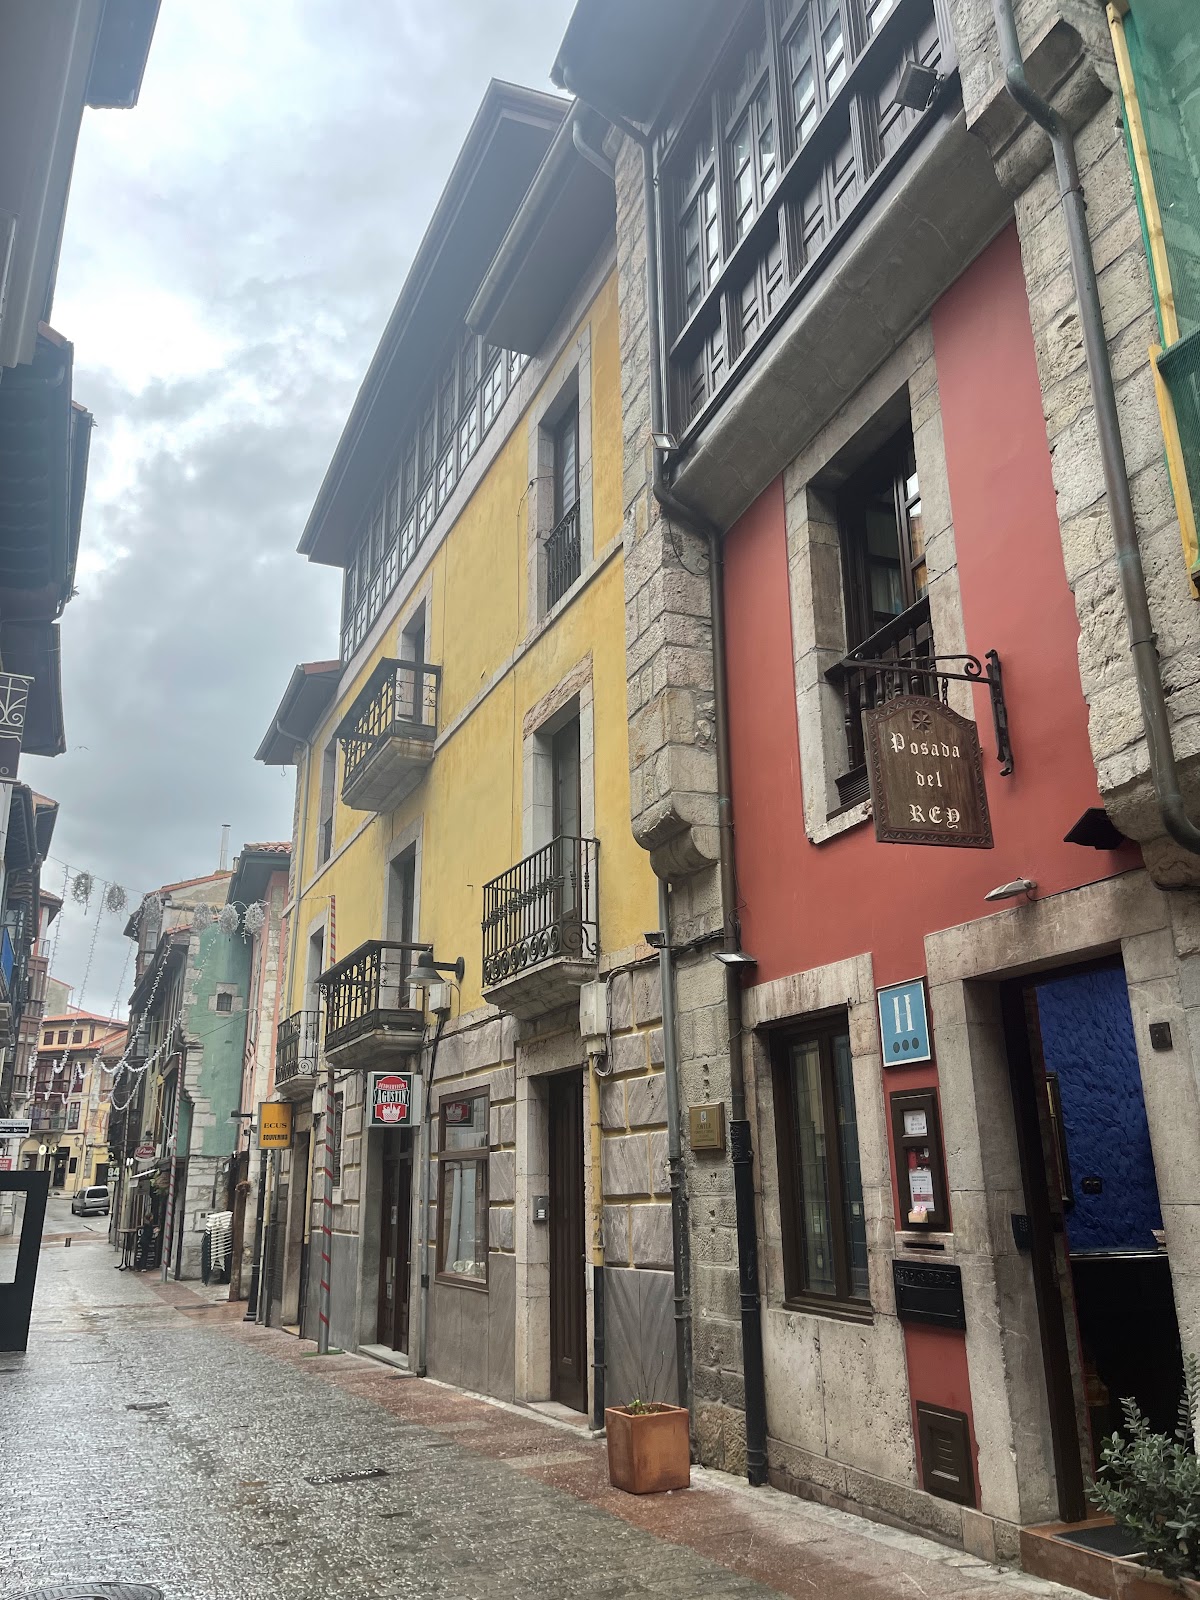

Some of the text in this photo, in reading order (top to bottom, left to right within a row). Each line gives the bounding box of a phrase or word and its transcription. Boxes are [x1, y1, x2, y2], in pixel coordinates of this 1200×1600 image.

[890, 731, 960, 758] Posada
[915, 770, 942, 788] del
[909, 804, 960, 829] REY
[891, 993, 915, 1035] H
[107, 1168, 120, 1177] 84
